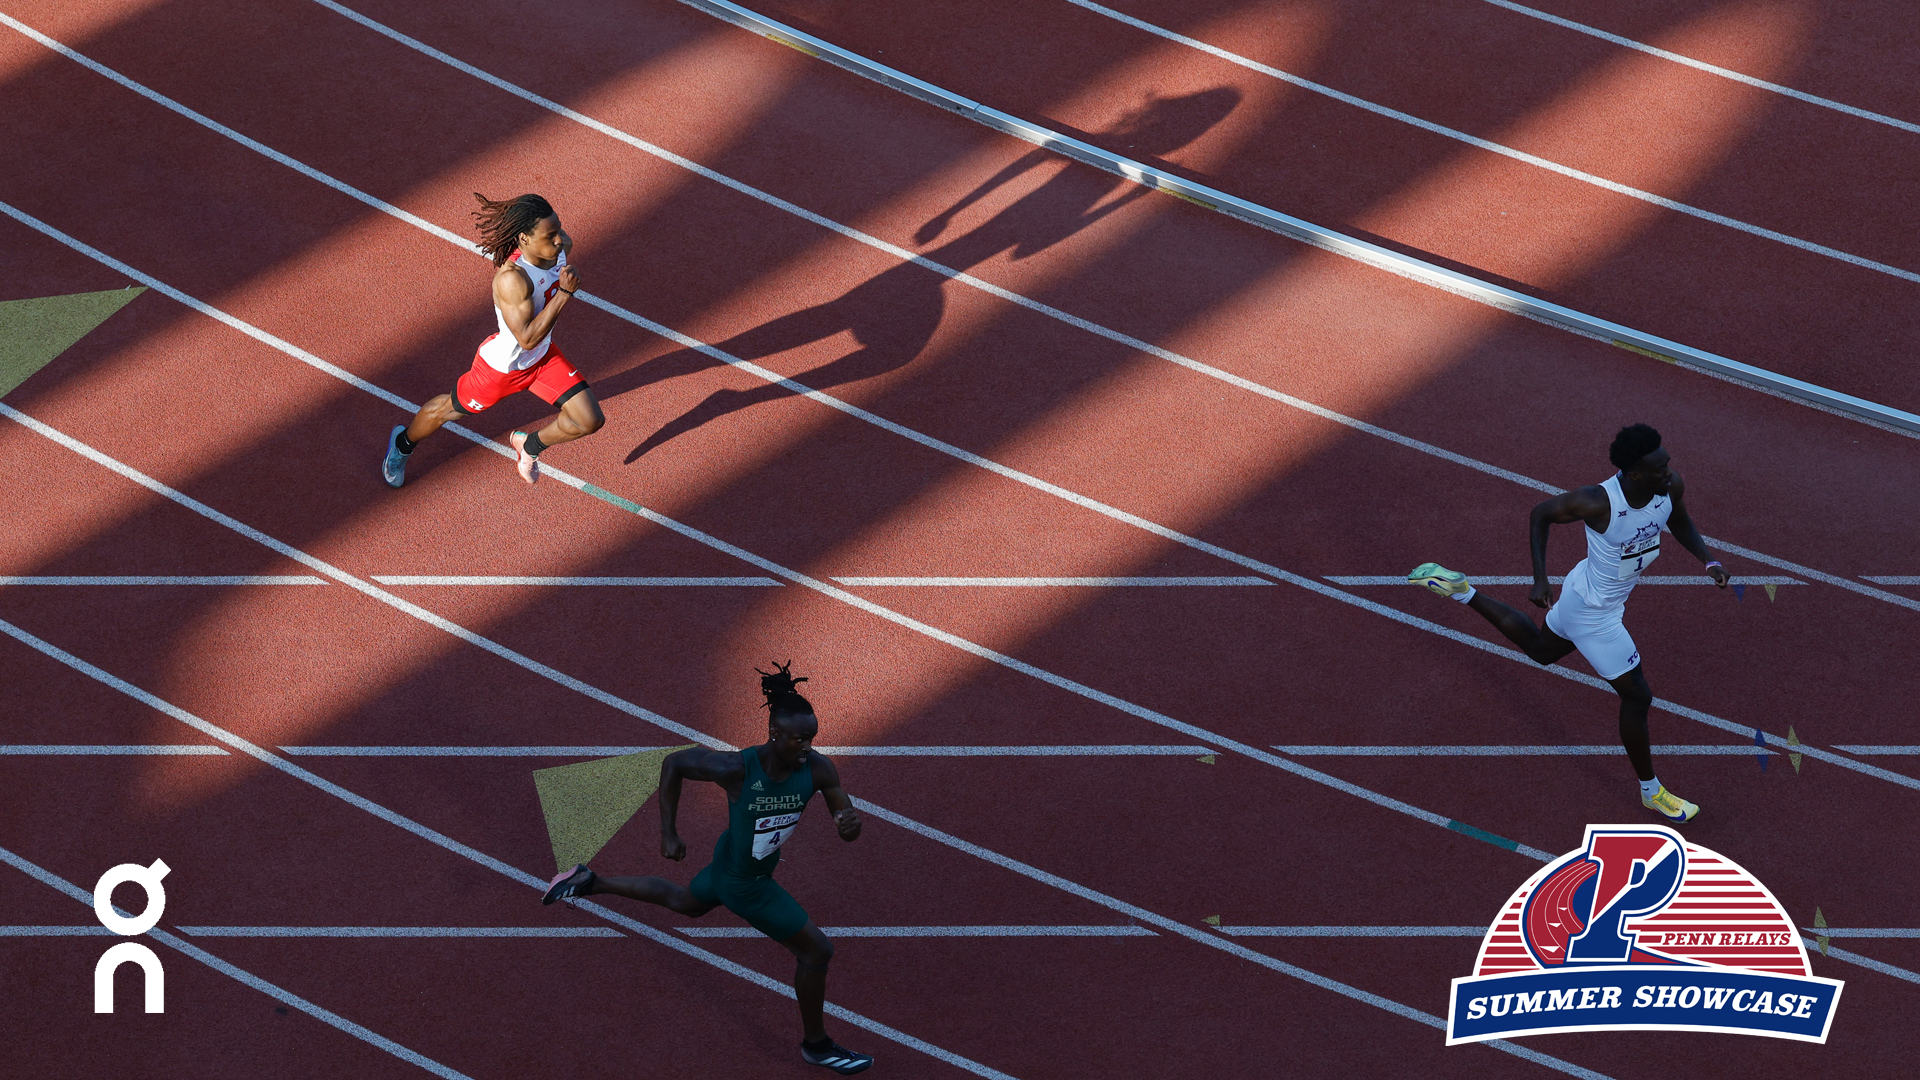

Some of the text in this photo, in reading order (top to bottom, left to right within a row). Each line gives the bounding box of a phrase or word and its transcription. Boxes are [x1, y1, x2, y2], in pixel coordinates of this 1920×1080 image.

[467, 399, 484, 411] R
[1634, 556, 1643, 572] 1
[756, 794, 800, 804] SOUTH
[748, 801, 804, 811] FLORIDA
[769, 831, 780, 845] 4
